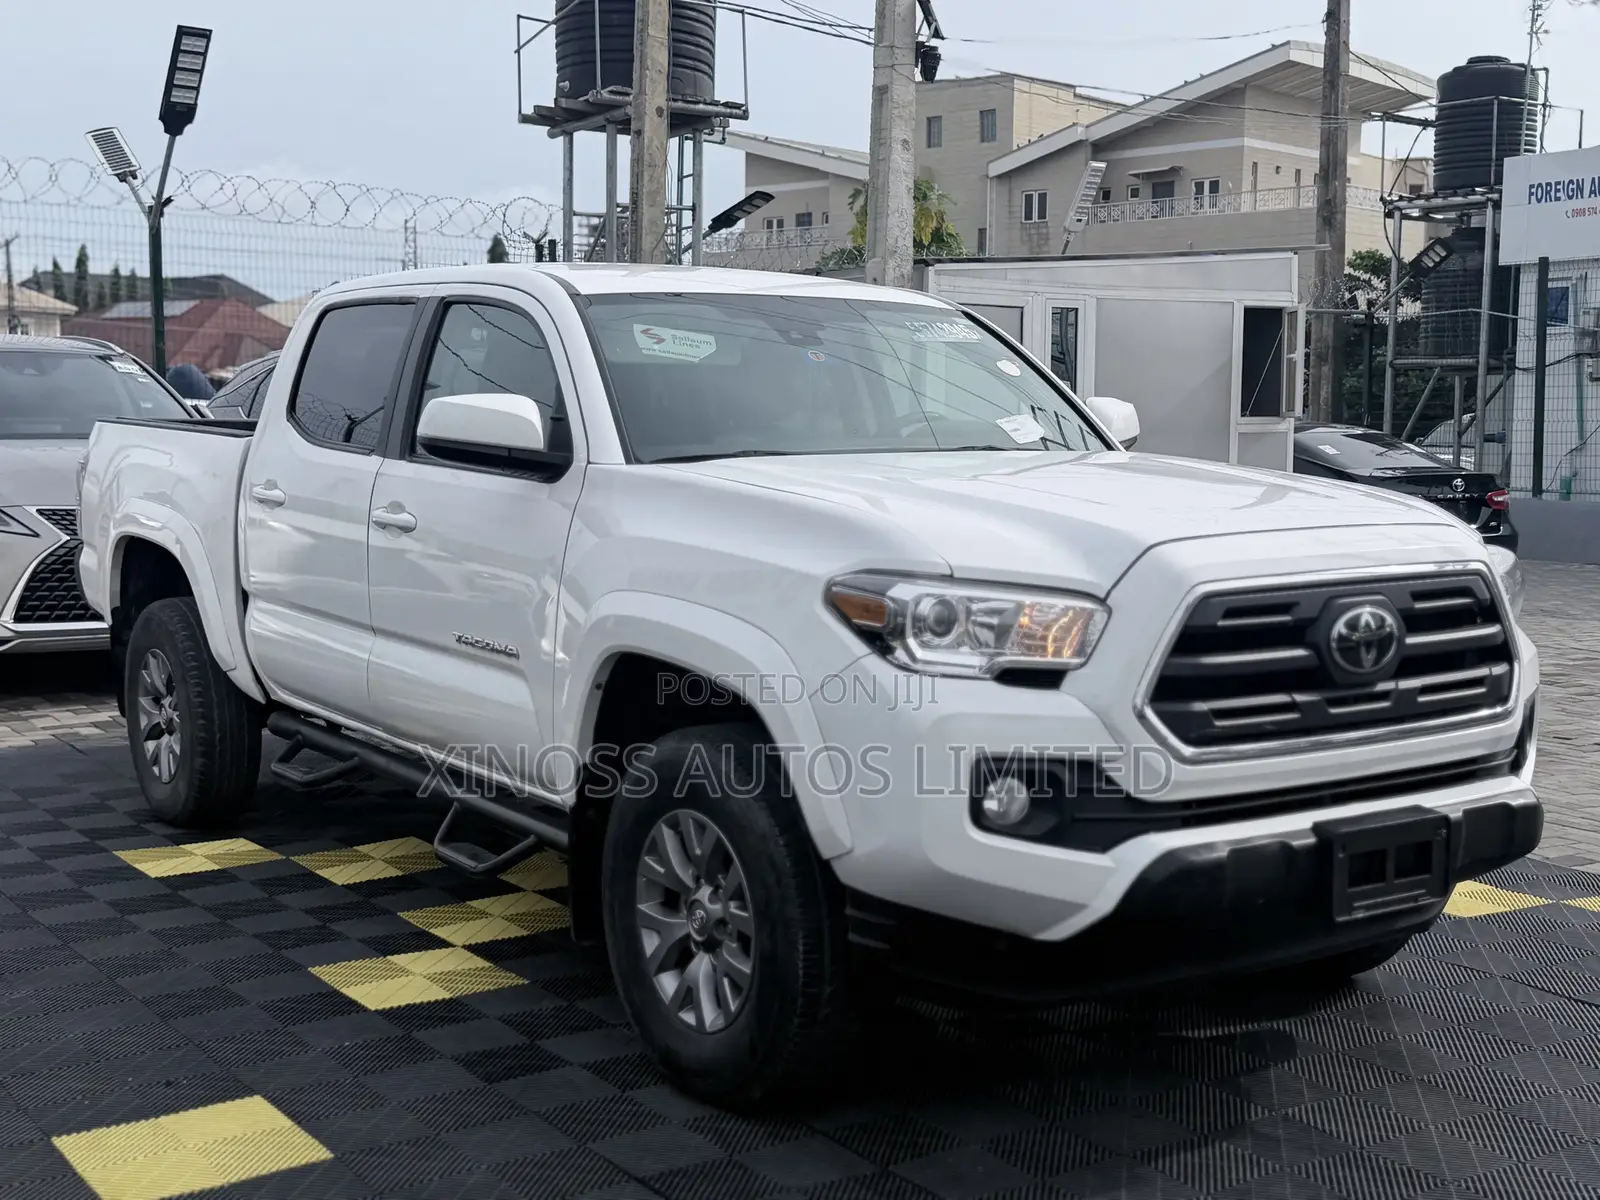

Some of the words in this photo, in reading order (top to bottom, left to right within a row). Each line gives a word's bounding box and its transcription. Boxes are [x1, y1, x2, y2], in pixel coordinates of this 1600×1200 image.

[1528, 178, 1584, 205] FOREIGN
[672, 339, 701, 349] Lines
[452, 631, 519, 659] TACOMA
